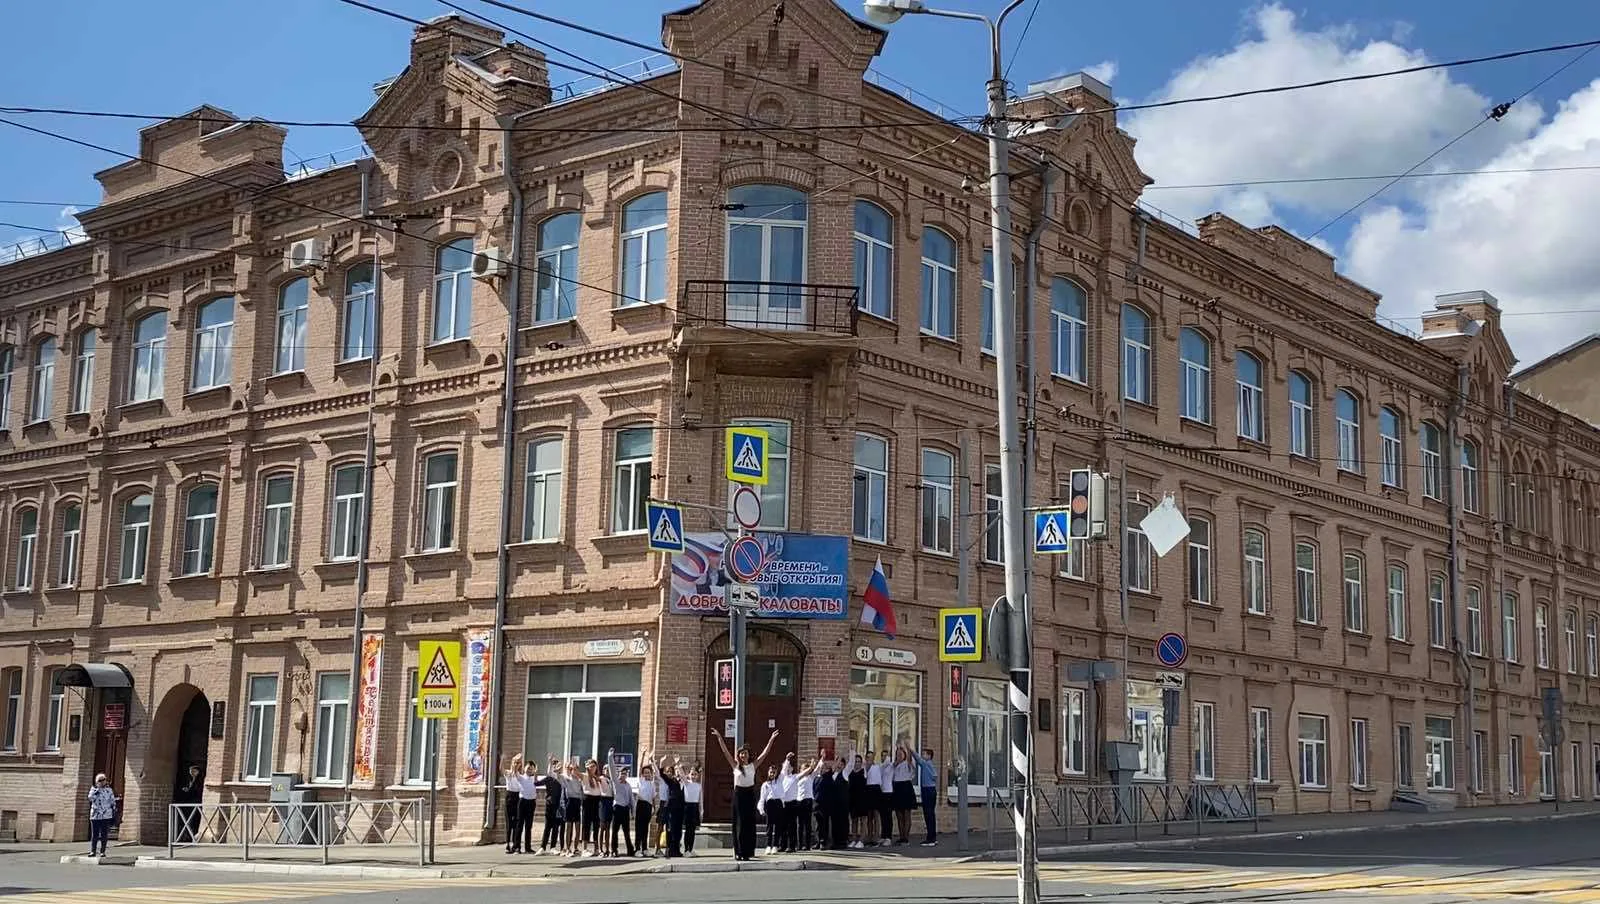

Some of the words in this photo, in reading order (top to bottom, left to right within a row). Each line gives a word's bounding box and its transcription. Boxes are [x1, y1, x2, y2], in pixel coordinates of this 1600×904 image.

[771, 562, 821, 572] ВРЕМЕНИ
[781, 574, 843, 584] ОТКРЫТИЯ!
[633, 640, 645, 653] 74
[861, 649, 869, 659] 51
[429, 699, 447, 708] 100м
